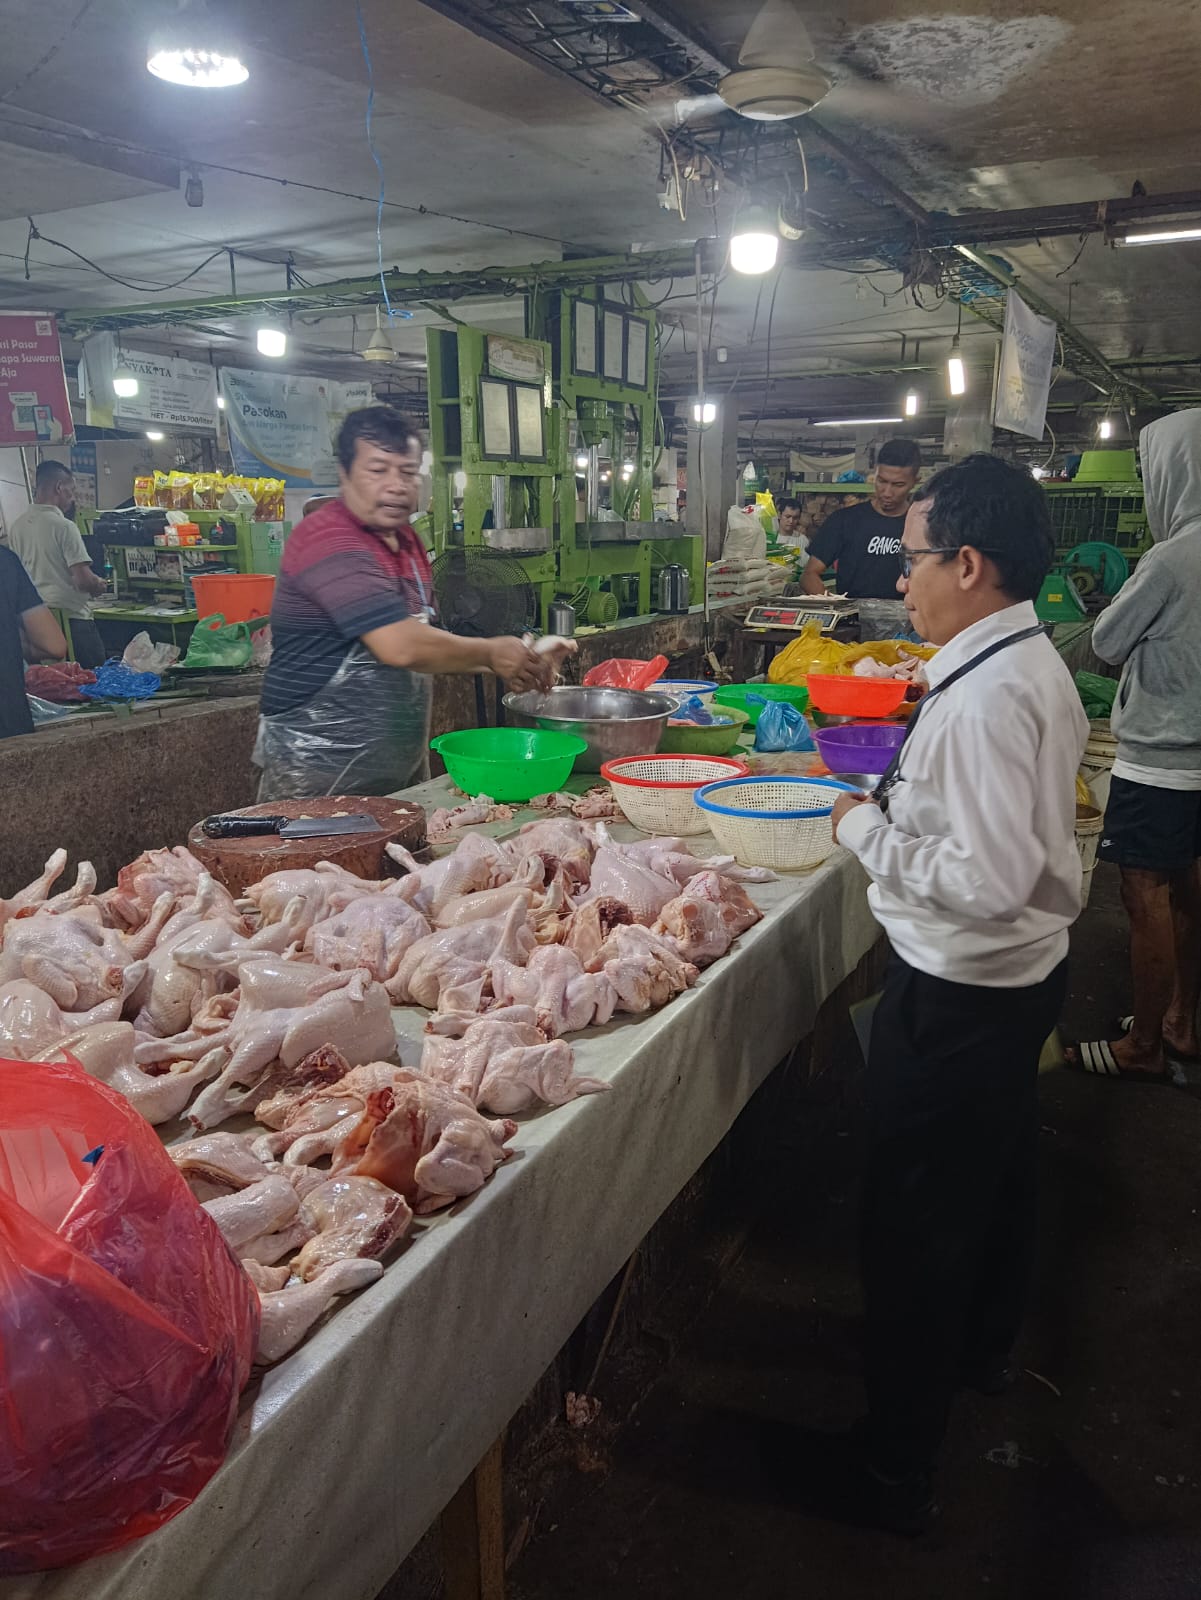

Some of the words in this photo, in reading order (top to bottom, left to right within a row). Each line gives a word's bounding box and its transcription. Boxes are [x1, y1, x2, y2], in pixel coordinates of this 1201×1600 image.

[11, 339, 38, 349] Pasar
[2, 367, 17, 378] Aja
[242, 404, 287, 420] Pasokan
